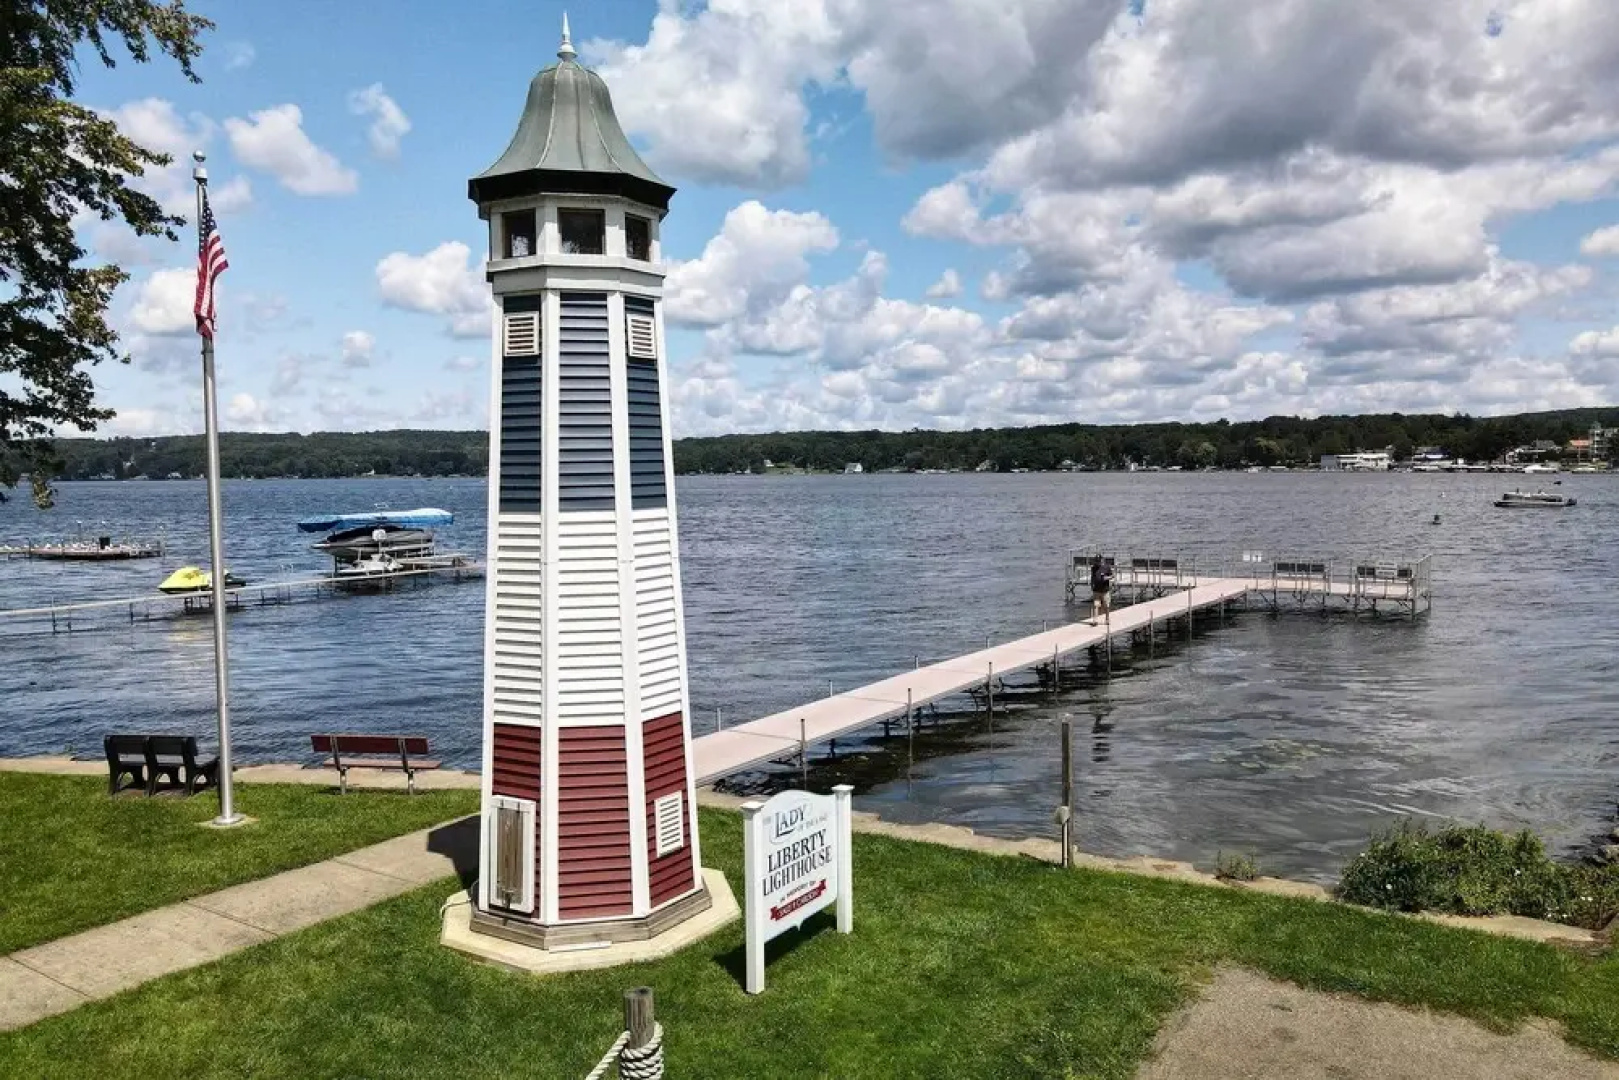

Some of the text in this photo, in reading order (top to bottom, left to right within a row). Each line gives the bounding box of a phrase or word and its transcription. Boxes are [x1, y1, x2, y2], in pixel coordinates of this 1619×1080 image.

[774, 803, 806, 838] LADY
[762, 845, 832, 896] LIGHTHOUSE
[768, 828, 827, 873] LIBERTY
